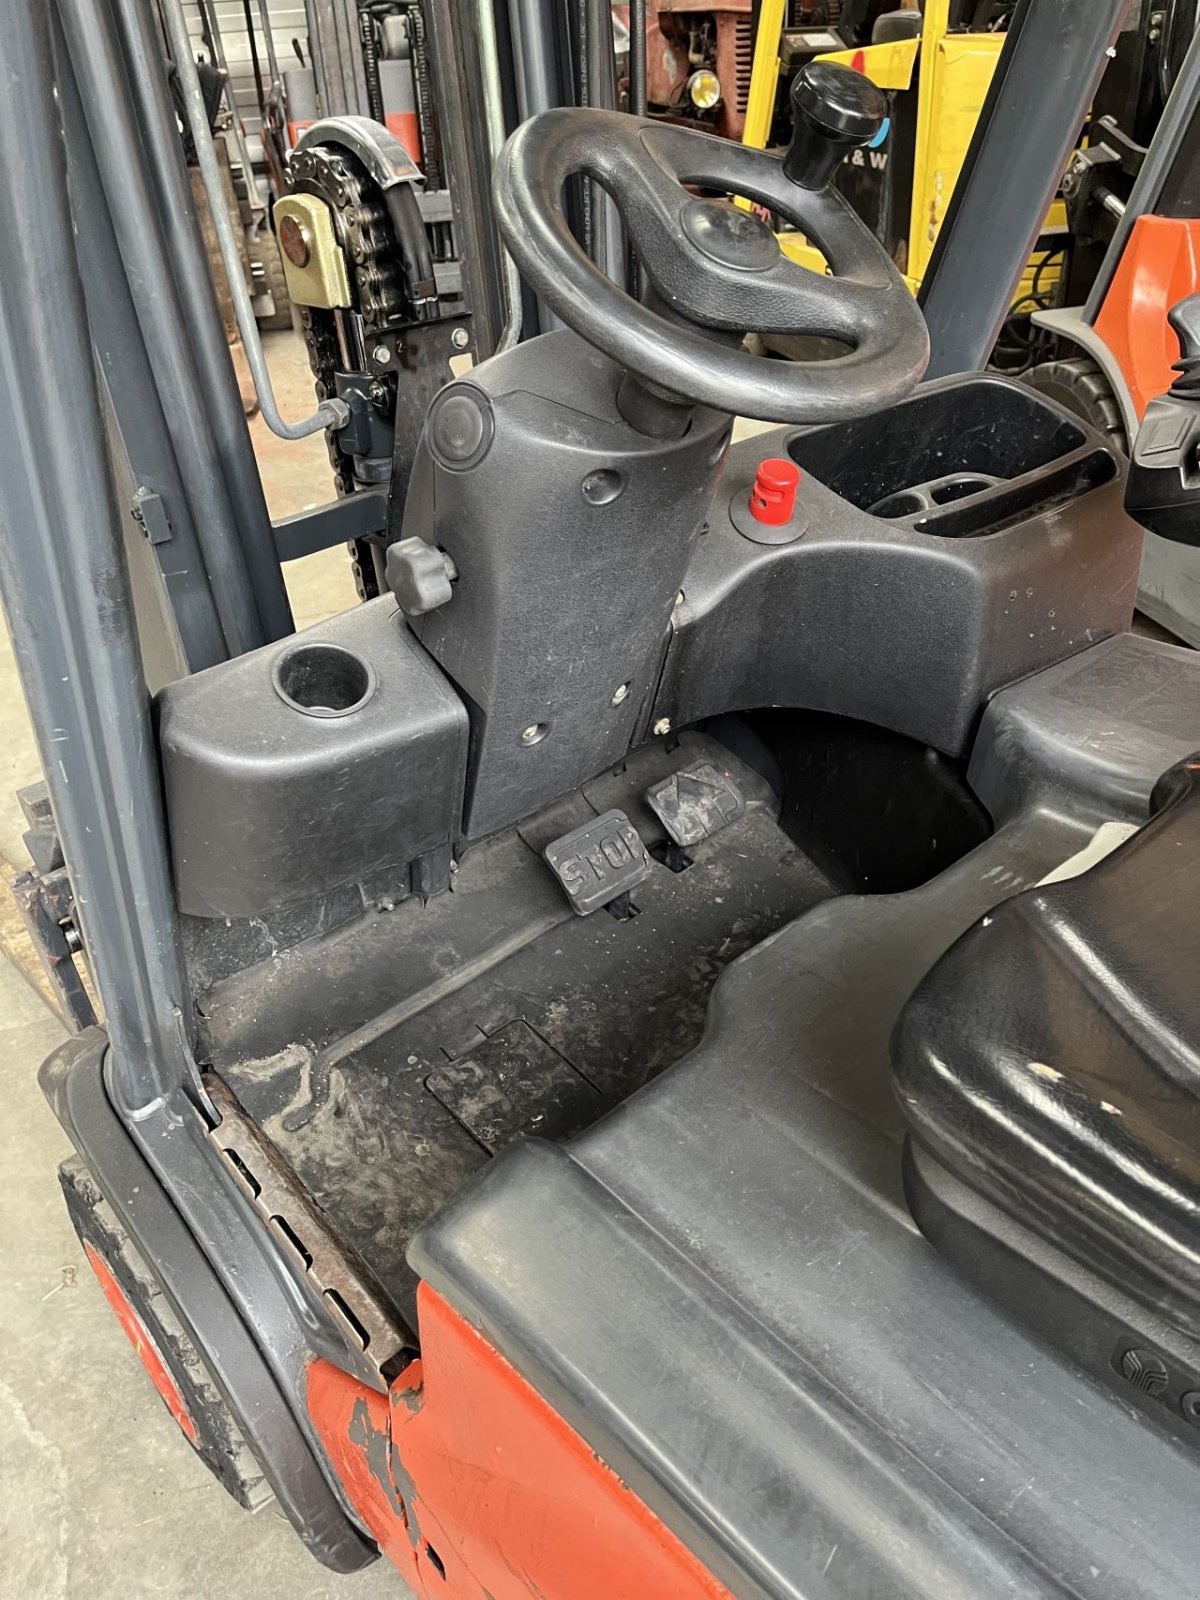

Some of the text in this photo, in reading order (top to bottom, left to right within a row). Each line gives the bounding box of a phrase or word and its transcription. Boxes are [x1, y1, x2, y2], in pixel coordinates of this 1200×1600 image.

[851, 149, 865, 167] &
[869, 151, 888, 170] W
[559, 825, 641, 895] STOP
